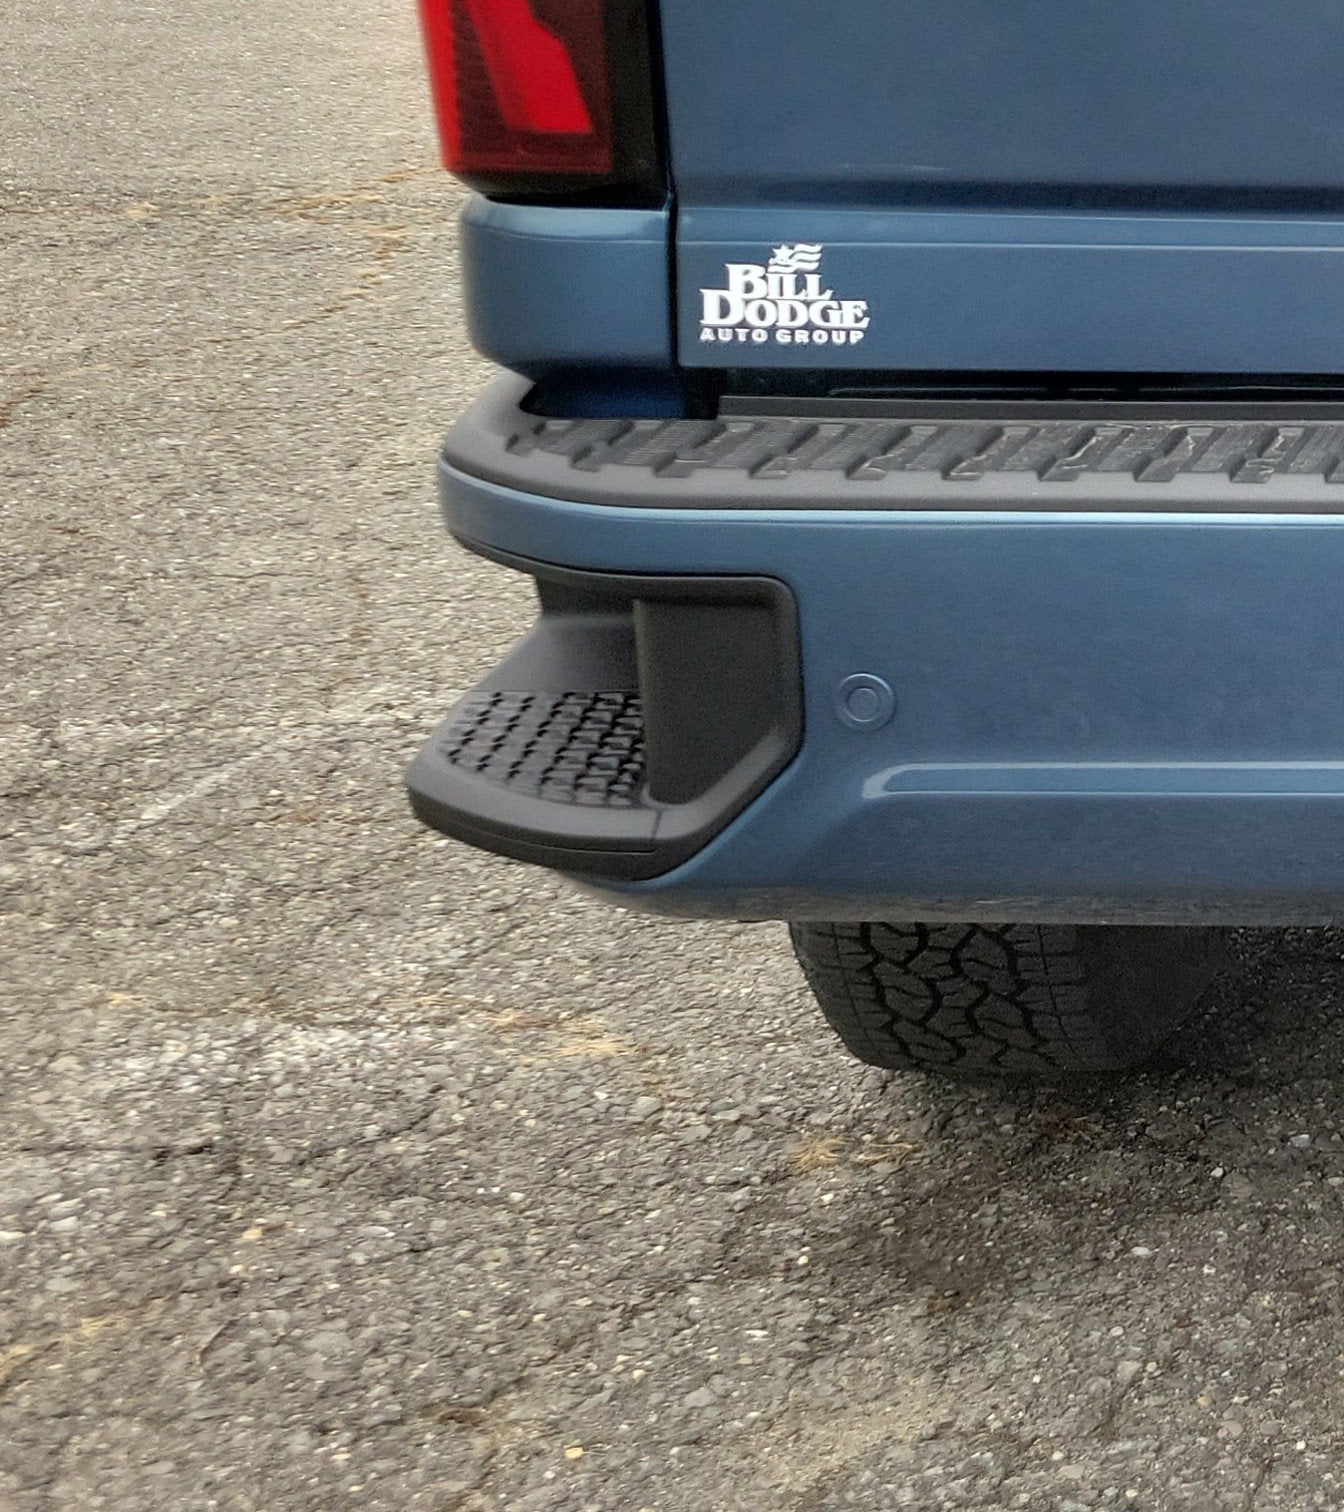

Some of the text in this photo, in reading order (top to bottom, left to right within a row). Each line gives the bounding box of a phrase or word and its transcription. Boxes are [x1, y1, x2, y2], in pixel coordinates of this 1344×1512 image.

[725, 263, 833, 300] BILL
[700, 288, 871, 329] DODGE
[700, 328, 864, 345] AUTO GROUP
